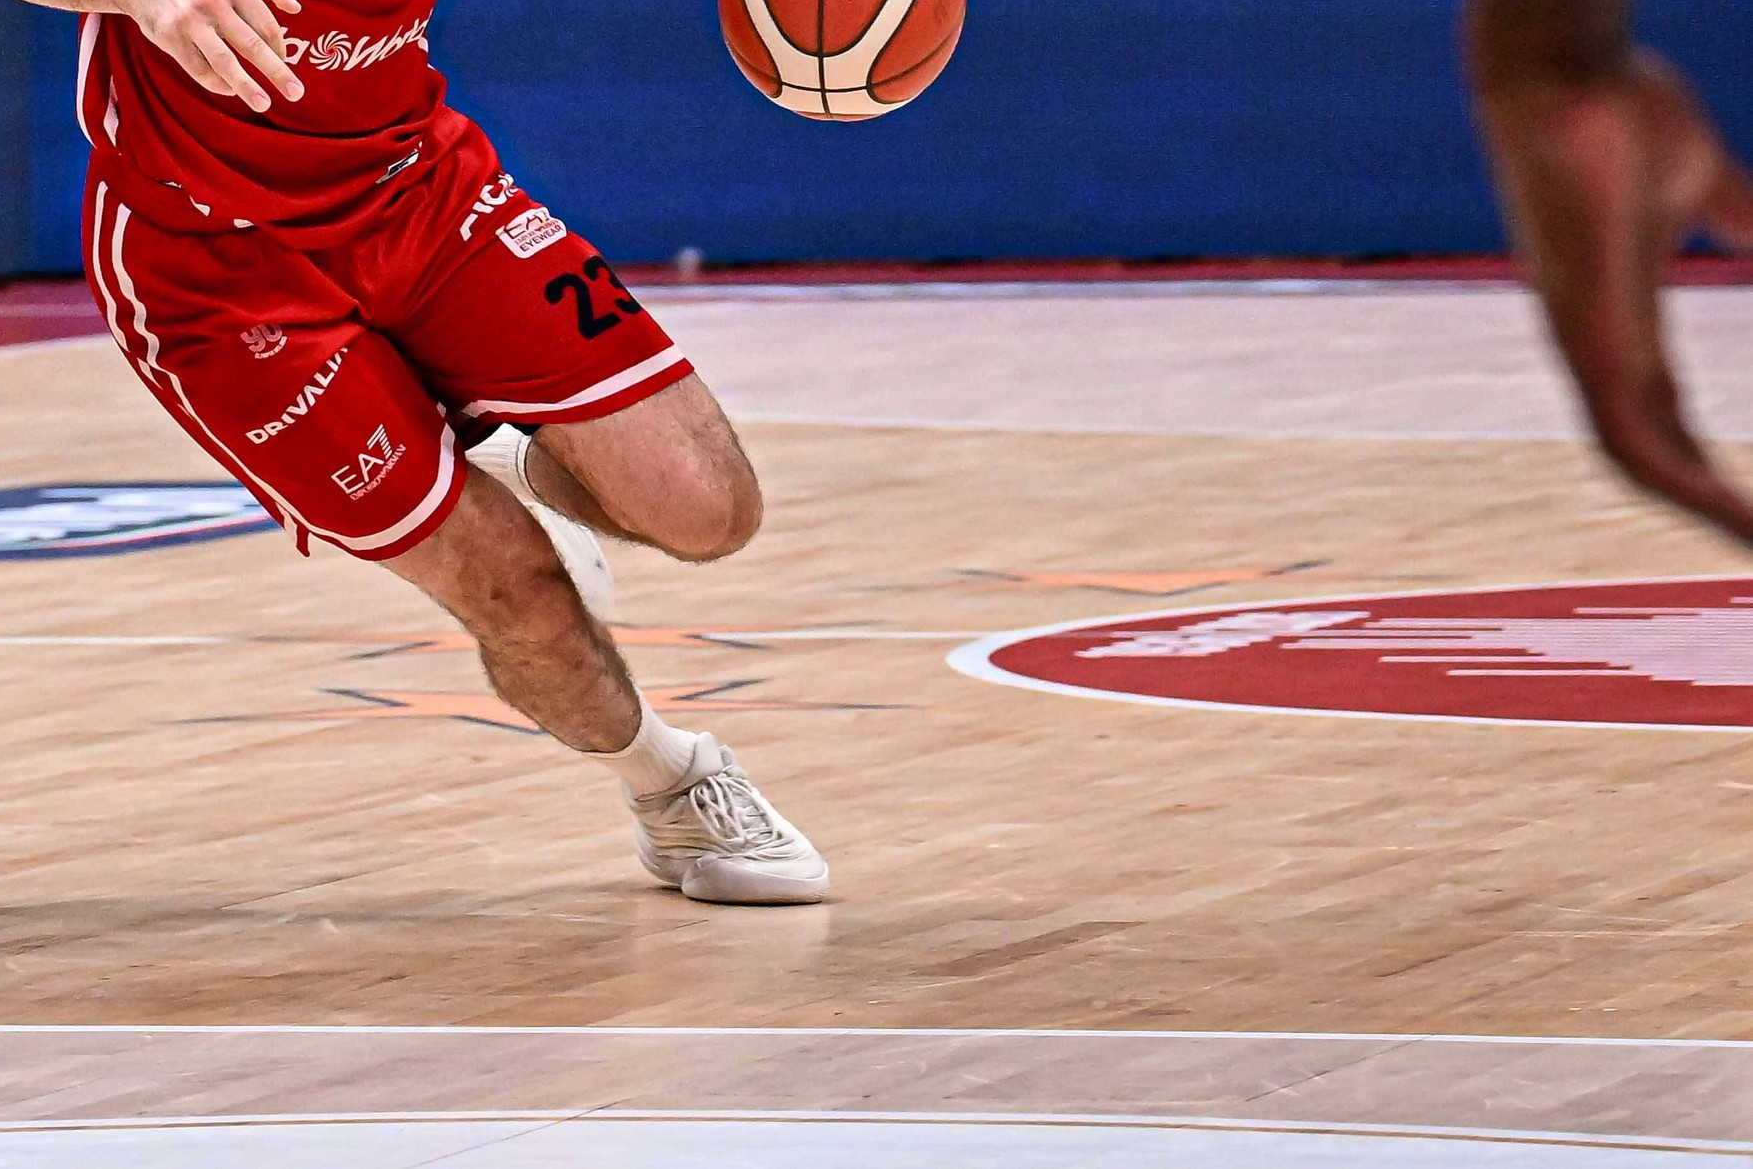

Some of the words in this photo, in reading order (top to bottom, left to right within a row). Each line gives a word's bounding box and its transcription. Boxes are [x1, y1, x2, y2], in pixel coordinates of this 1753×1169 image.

[519, 224, 562, 252] EYEWEAR
[544, 255, 643, 340] 23
[331, 423, 393, 495] EA7
